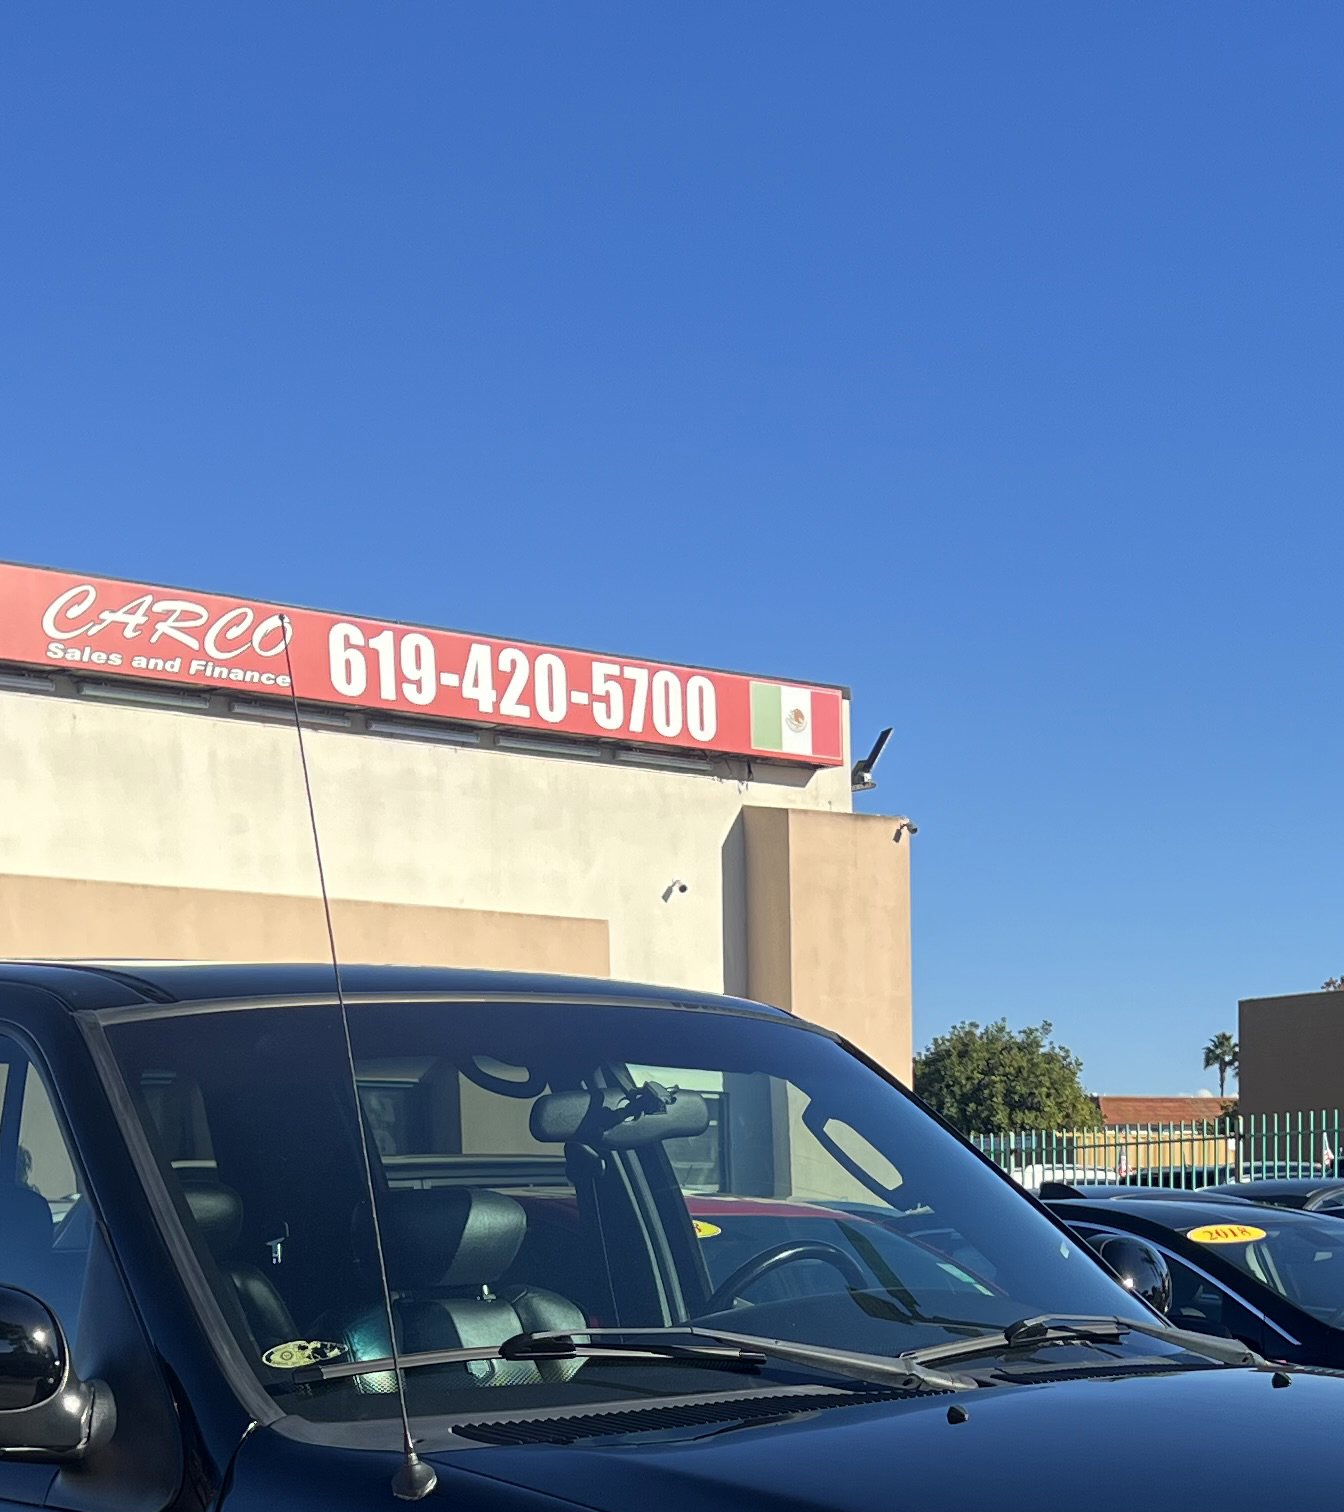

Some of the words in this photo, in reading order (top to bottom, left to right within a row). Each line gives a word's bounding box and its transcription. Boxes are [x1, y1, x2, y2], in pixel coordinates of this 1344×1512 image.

[41, 583, 294, 660] CARCO
[46, 641, 123, 666] Sales
[131, 654, 182, 673] and
[188, 659, 292, 687] Finance
[327, 621, 718, 742] 619-420-5700
[1202, 1226, 1252, 1241] 2018
